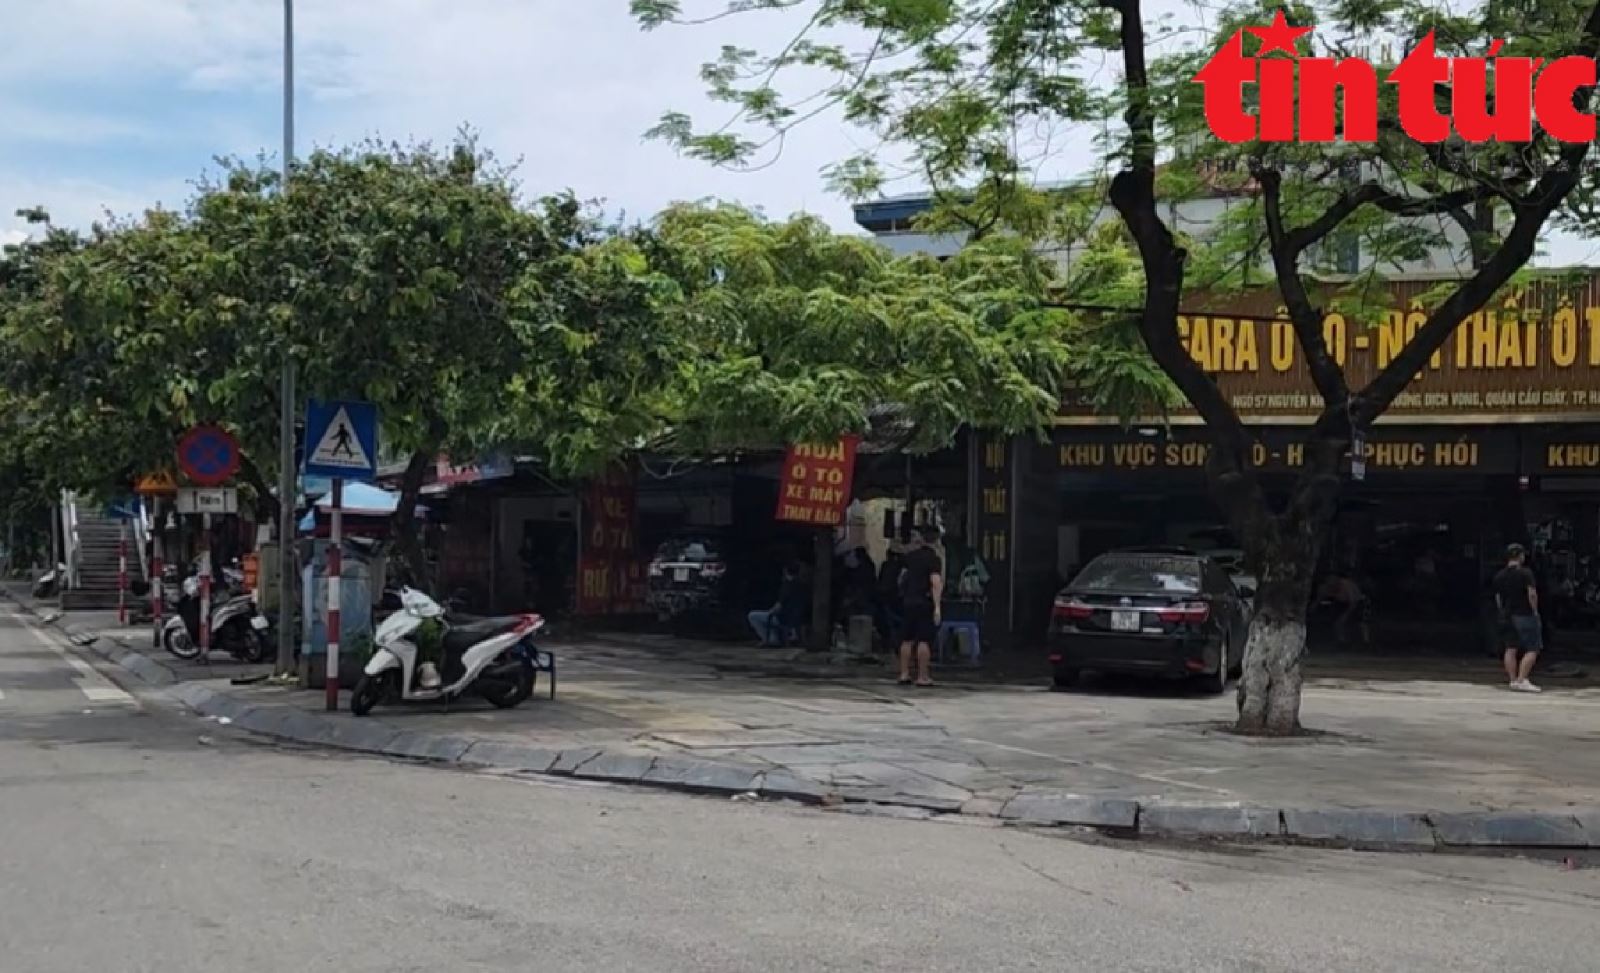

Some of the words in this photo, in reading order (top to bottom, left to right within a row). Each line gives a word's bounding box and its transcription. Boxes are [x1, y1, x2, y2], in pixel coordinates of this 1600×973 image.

[1060, 443, 1104, 467] KHU
[1113, 441, 1156, 471] VỰC
[1547, 443, 1600, 467] KHU
[814, 466, 843, 485] TÔ
[786, 483, 805, 499] XE
